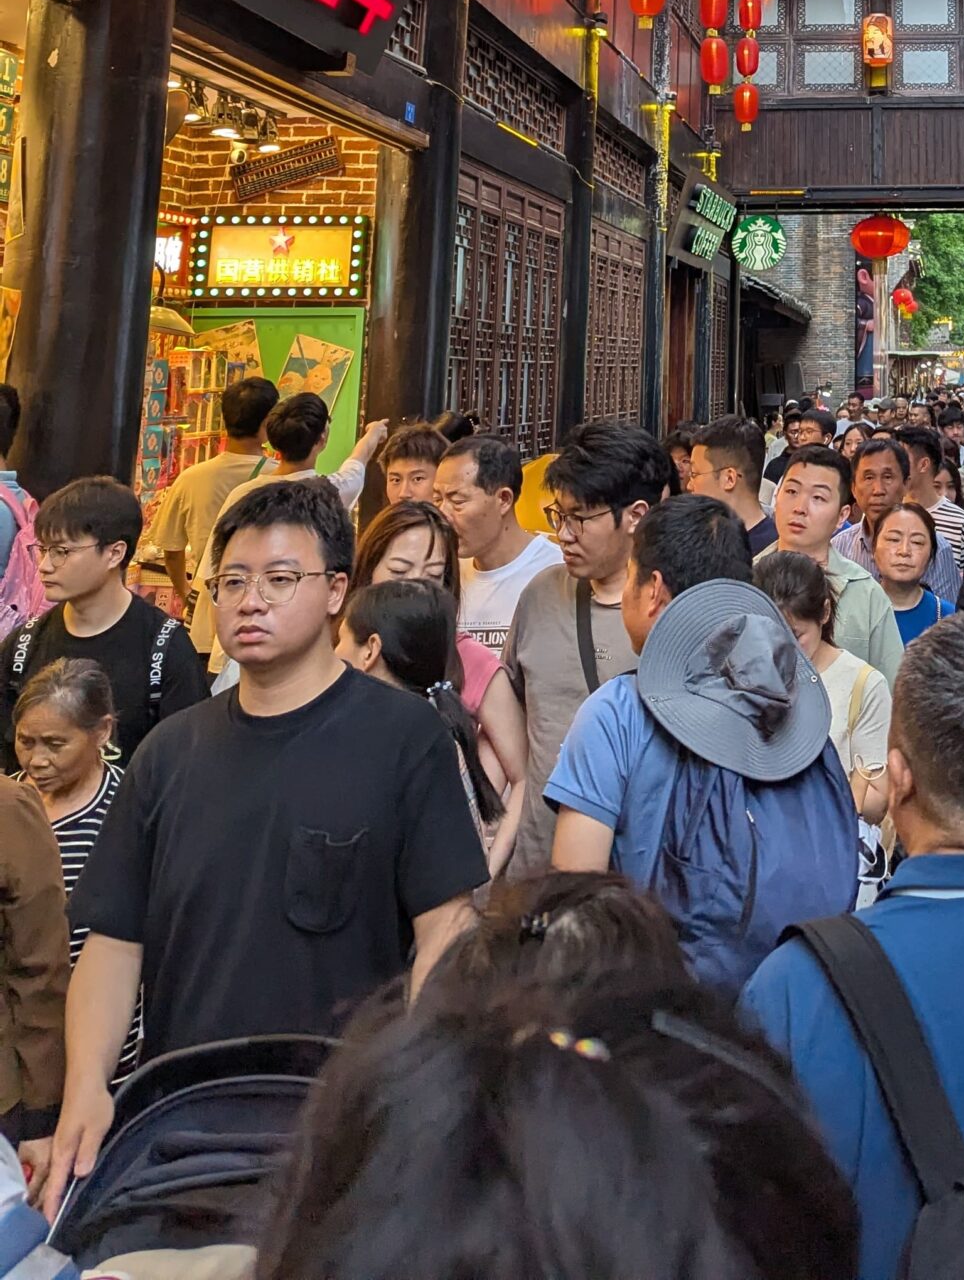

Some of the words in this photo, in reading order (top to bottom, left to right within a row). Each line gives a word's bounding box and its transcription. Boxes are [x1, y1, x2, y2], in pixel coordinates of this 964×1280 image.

[695, 184, 738, 232] STARBUCKS
[691, 226, 719, 261] COFFEE
[215, 257, 342, 284] 国营供销社
[12, 633, 32, 674] DIDAS
